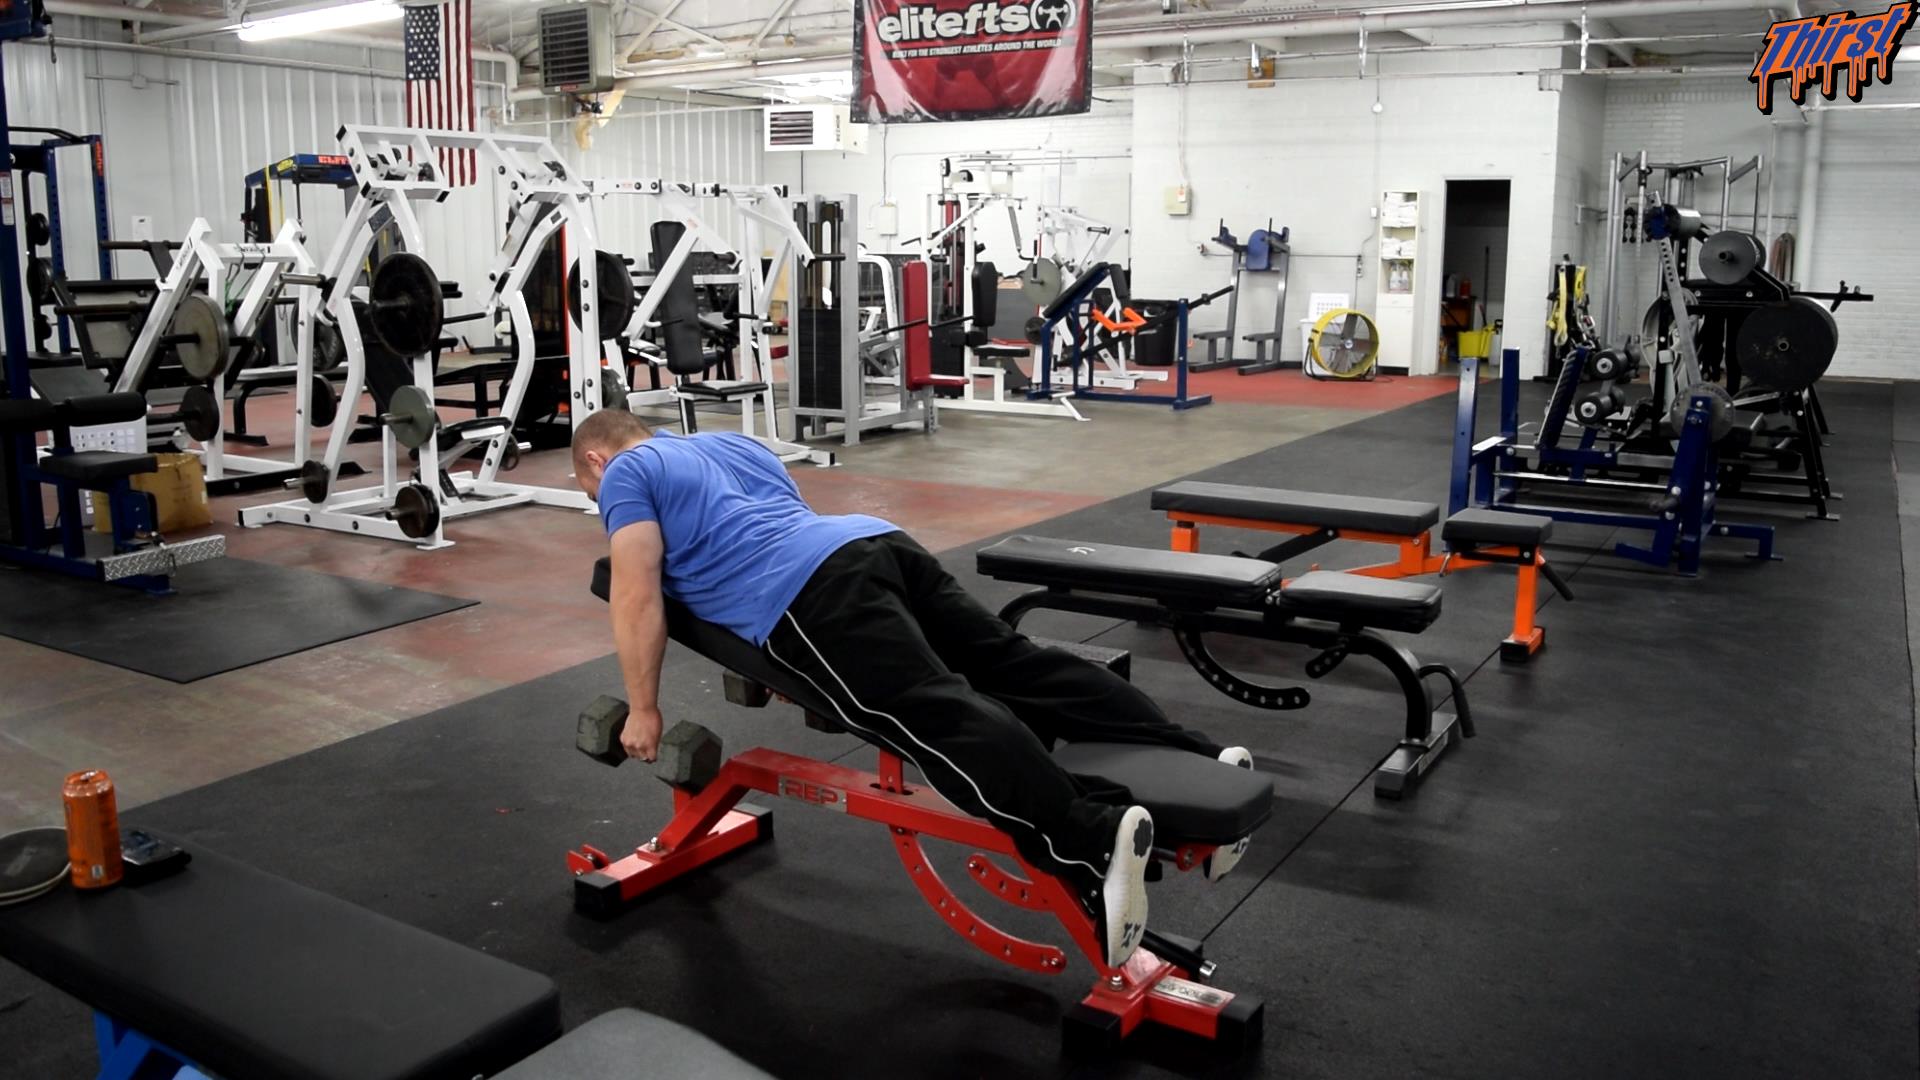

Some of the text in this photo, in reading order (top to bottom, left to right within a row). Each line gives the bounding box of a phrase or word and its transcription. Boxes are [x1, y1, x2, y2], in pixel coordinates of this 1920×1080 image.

[878, 2, 1029, 42] elitefts
[963, 43, 993, 54] ATHLETES
[994, 41, 1022, 52] AROUND
[1022, 40, 1036, 50] THE
[1037, 38, 1062, 48] WORLD
